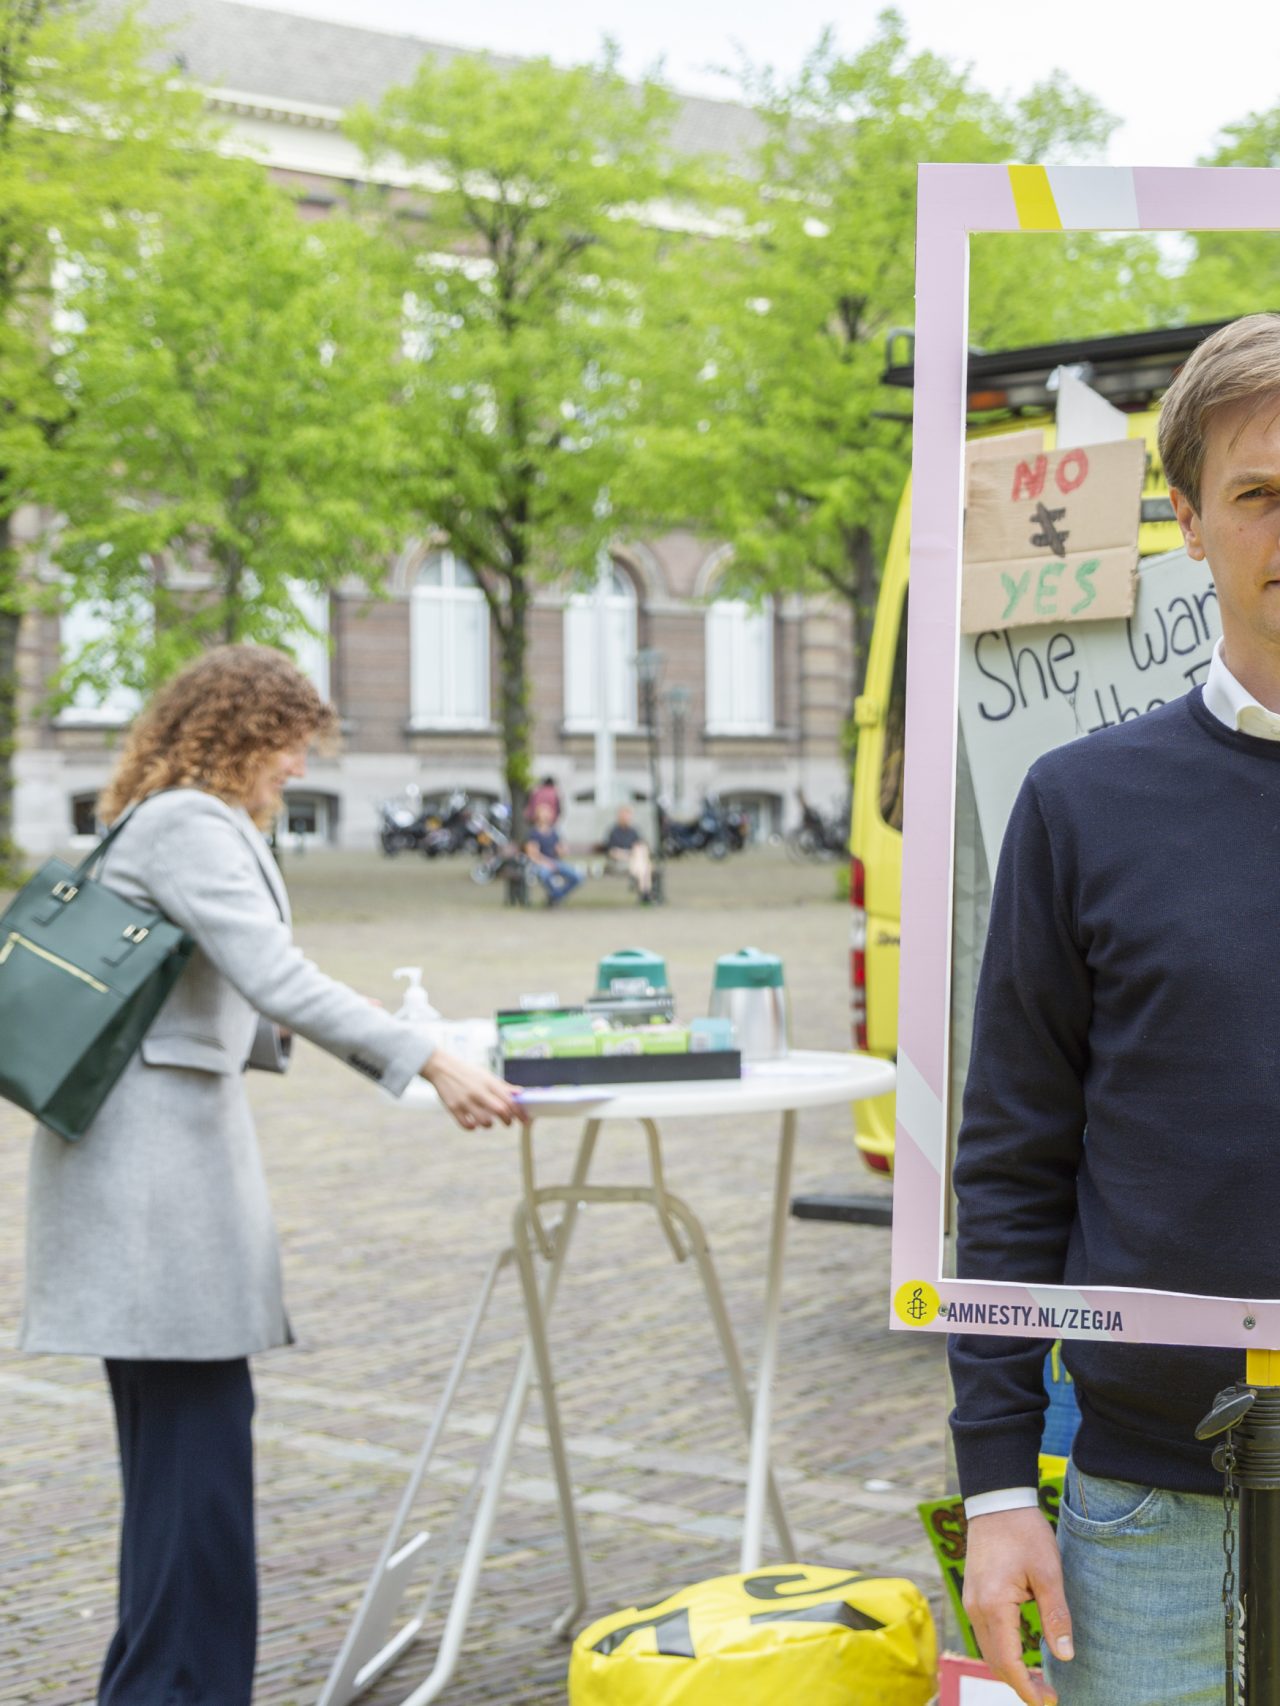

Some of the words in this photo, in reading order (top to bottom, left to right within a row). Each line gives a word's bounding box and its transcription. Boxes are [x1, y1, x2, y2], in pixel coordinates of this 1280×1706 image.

[1011, 448, 1089, 501] NO
[1001, 558, 1102, 620] YES
[974, 628, 1080, 721] She
[946, 1301, 1124, 1332] AMNESTY.NL/ZEGJA
